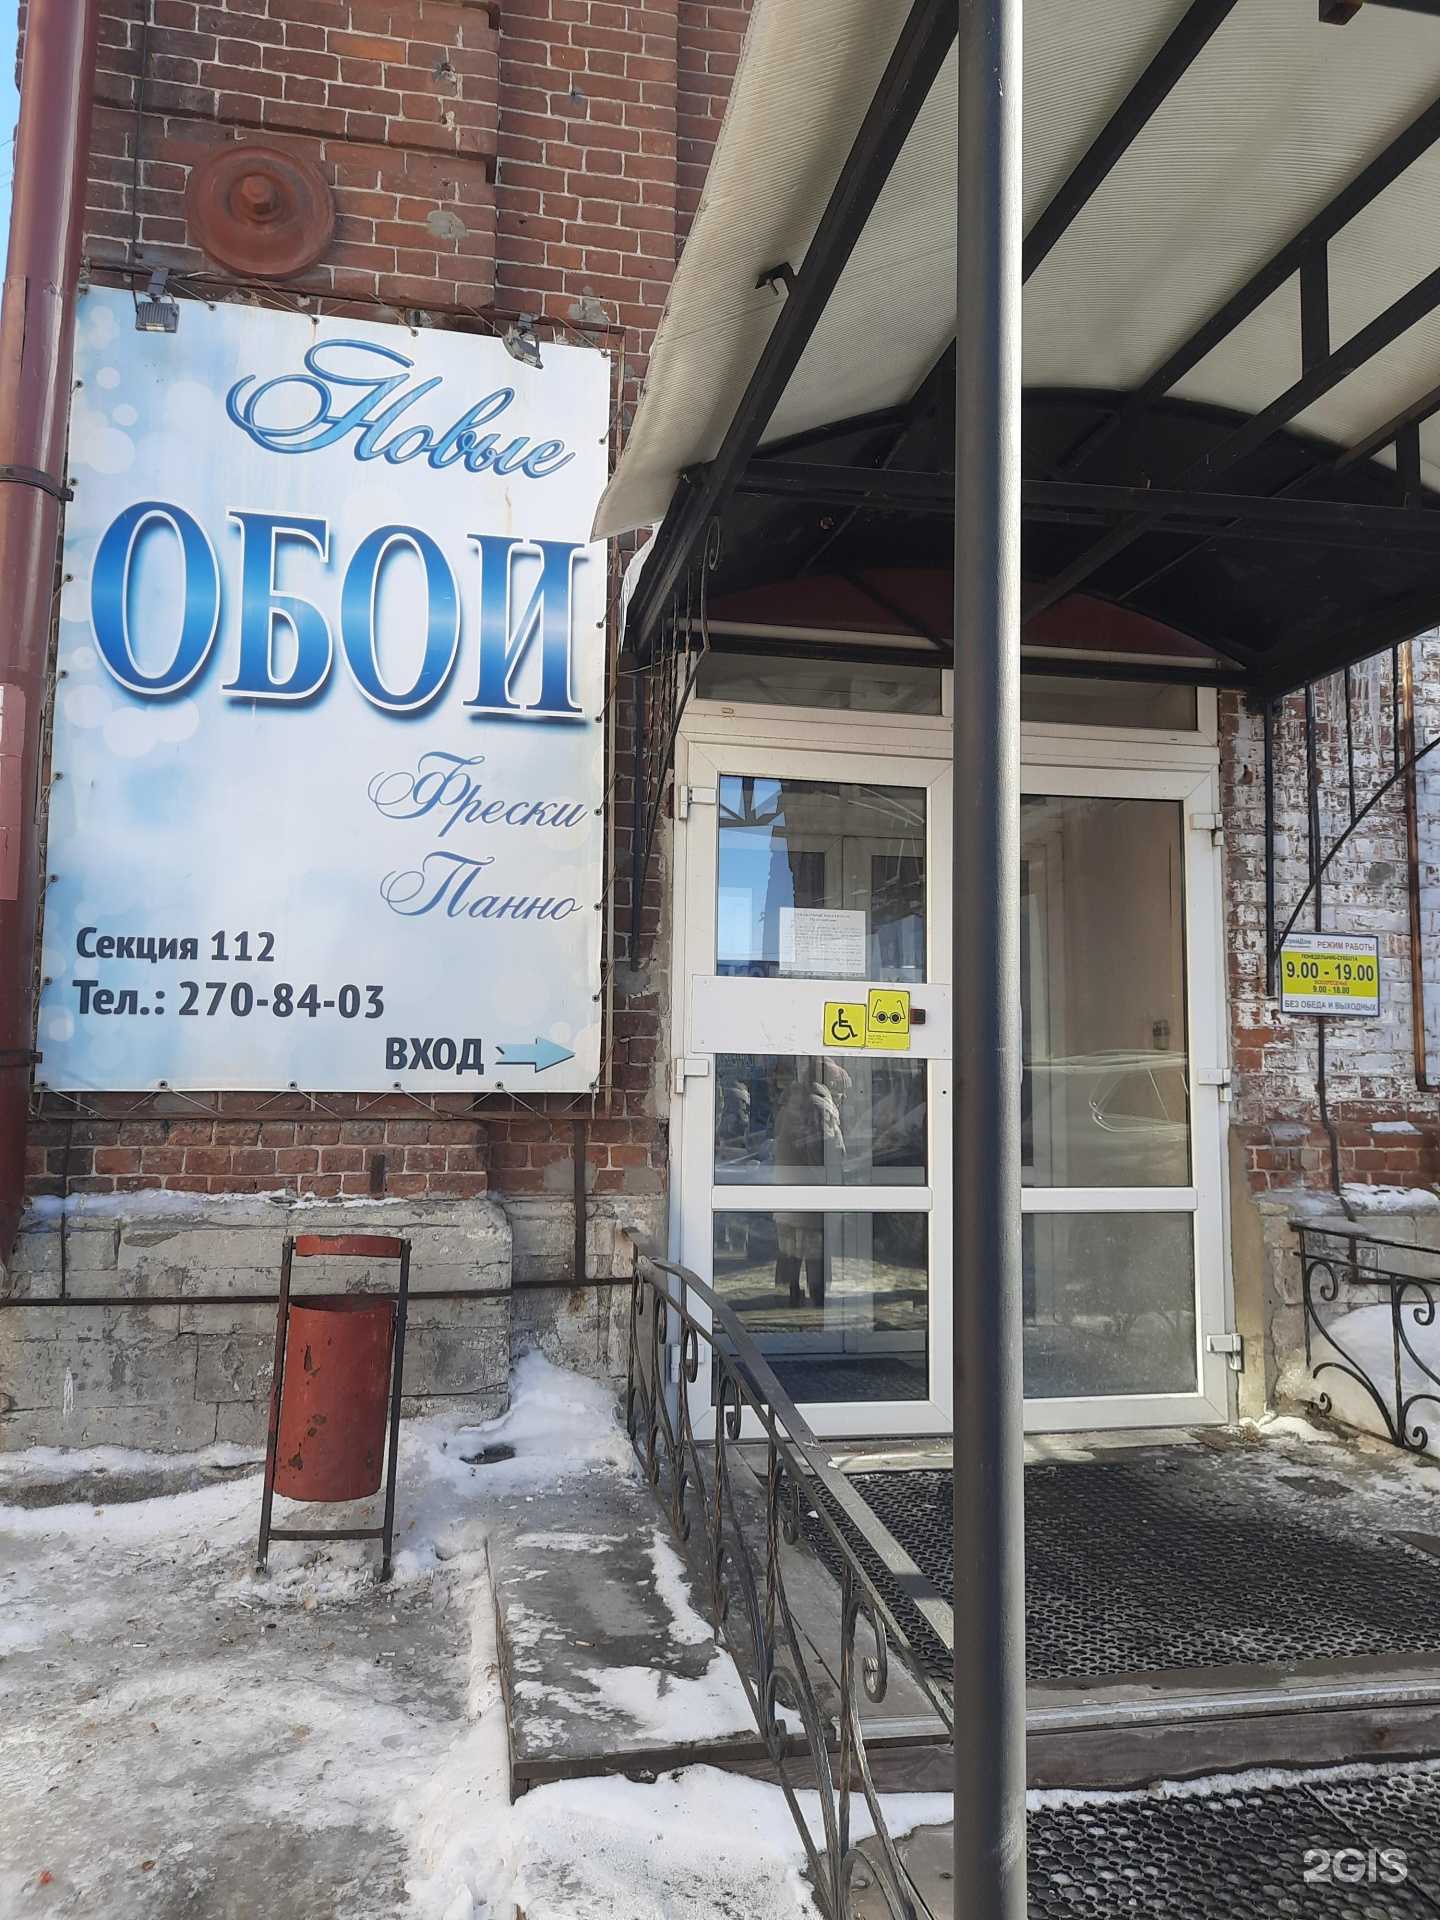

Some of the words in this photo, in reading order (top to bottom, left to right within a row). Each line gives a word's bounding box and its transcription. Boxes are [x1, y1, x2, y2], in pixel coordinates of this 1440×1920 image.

[226, 339, 575, 478] Новые
[90, 501, 586, 716] ОБОИ
[368, 751, 586, 837] Фрески
[380, 850, 584, 921] Панно
[76, 927, 198, 963] Секция
[210, 931, 275, 962] 112
[1317, 941, 1344, 950] РЕЖИМ
[1345, 942, 1375, 951] РАБОТЫ
[1286, 961, 1319, 979] 9.00
[1335, 963, 1374, 981] 19.00
[73, 980, 165, 1015] Тел.:
[178, 981, 385, 1018] 270-84-03
[1284, 999, 1299, 1008] БЕЗ
[1301, 1000, 1326, 1009] ОБЕДА
[385, 1037, 484, 1074] ВХОД
